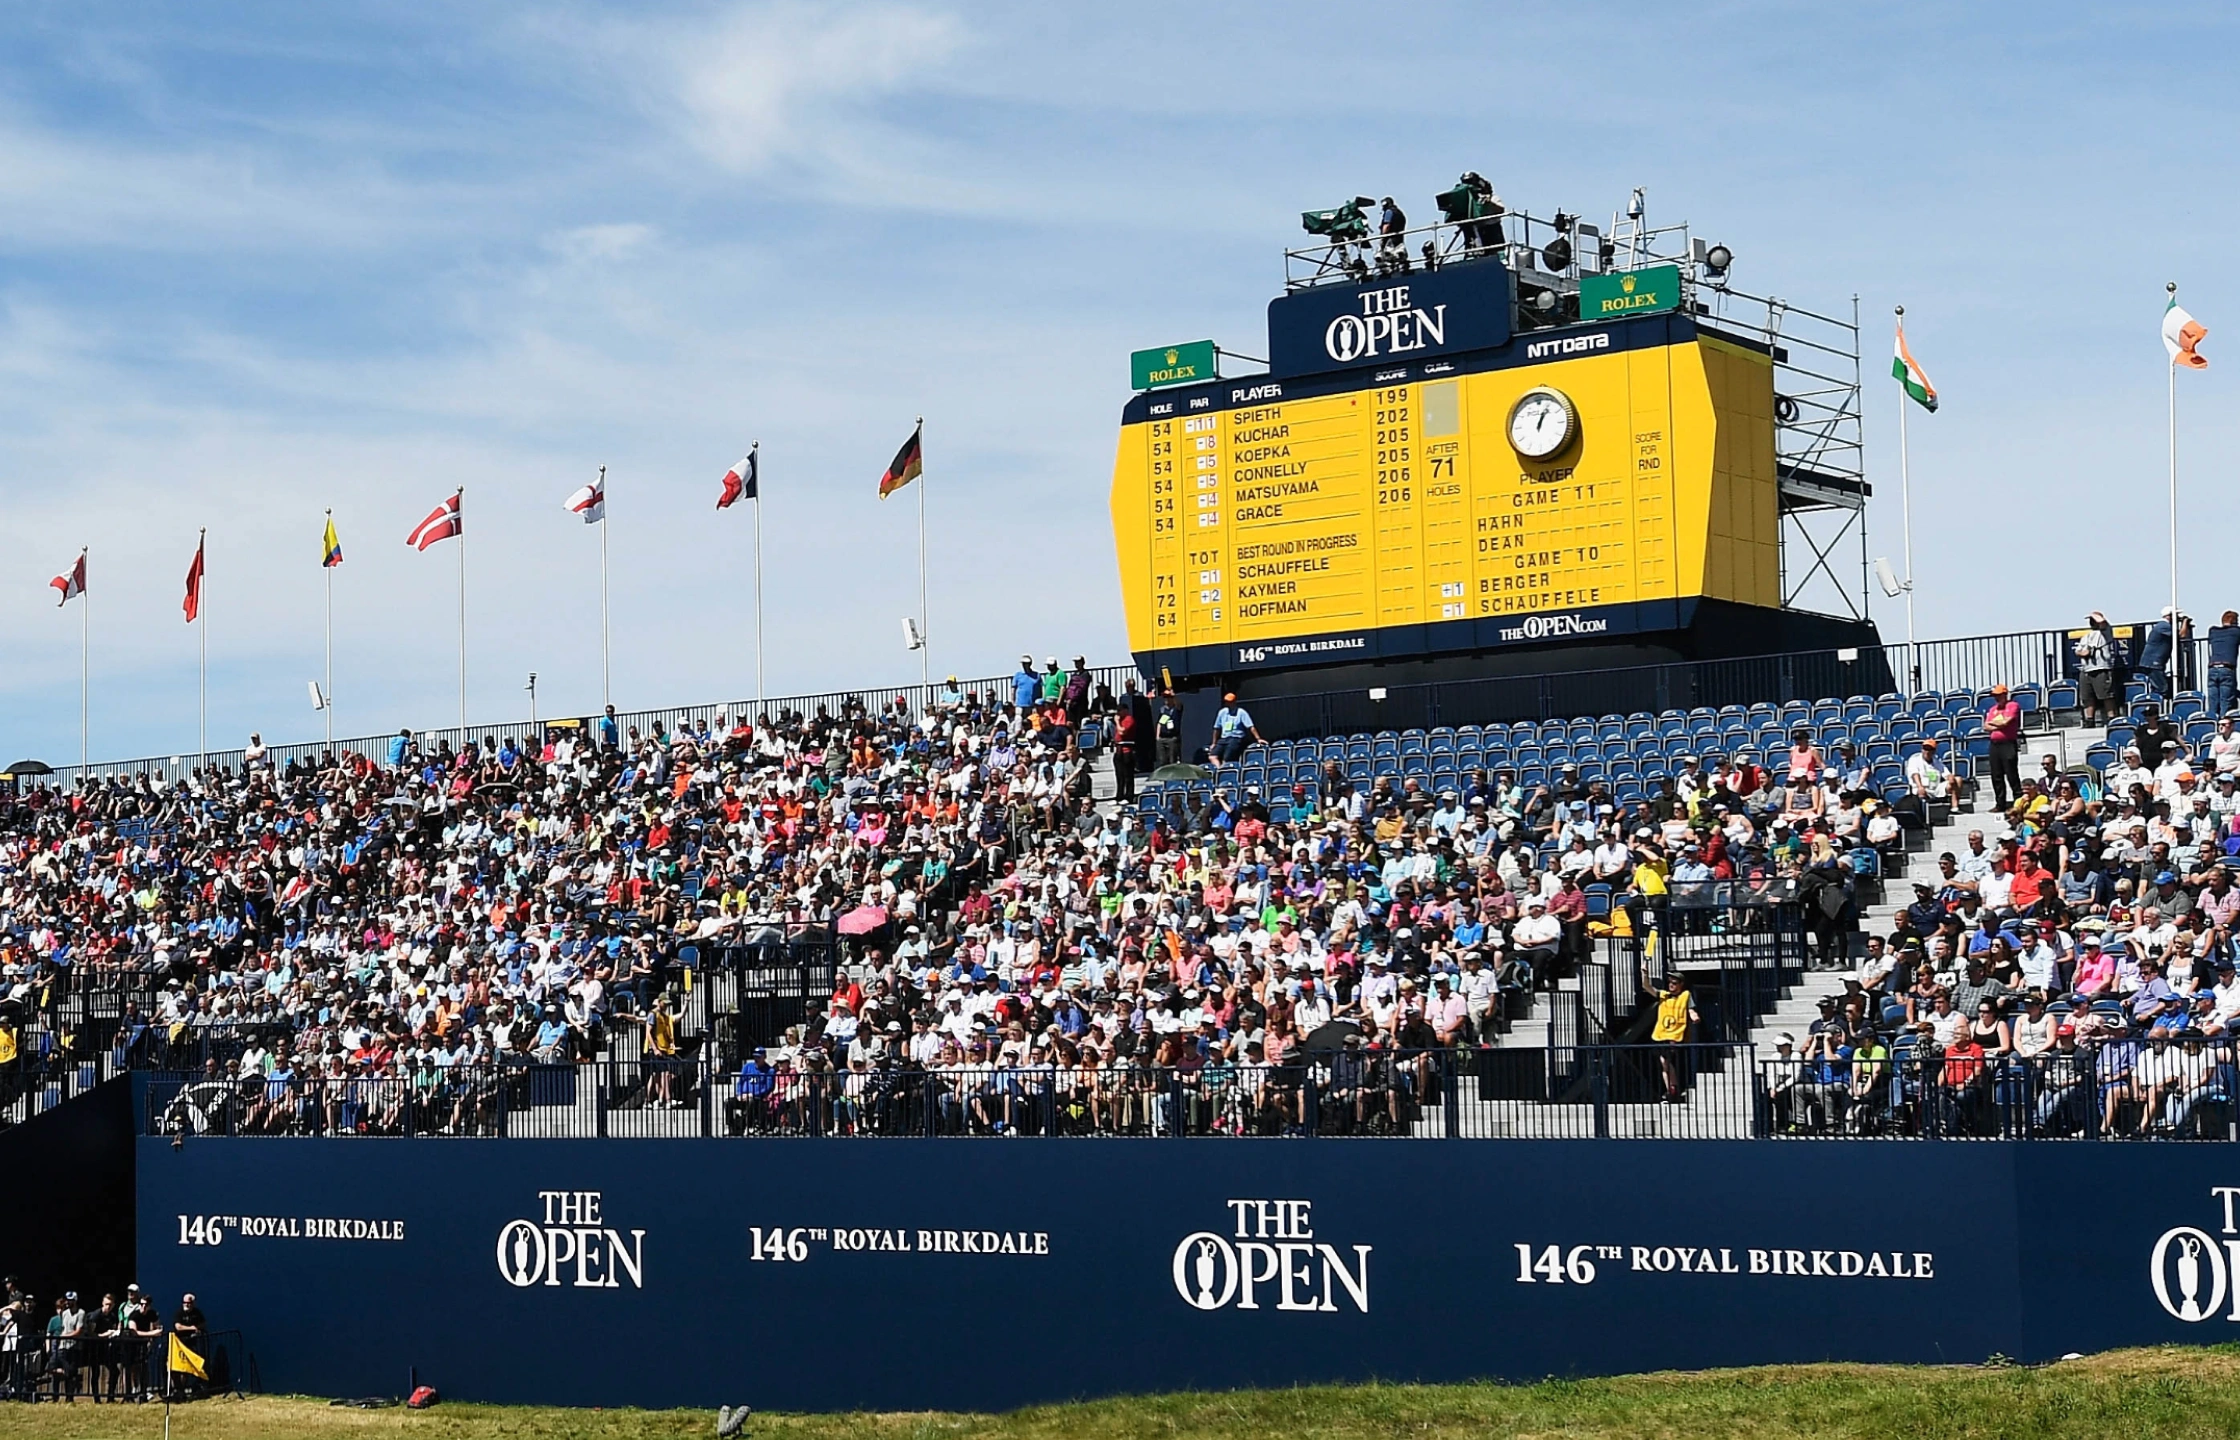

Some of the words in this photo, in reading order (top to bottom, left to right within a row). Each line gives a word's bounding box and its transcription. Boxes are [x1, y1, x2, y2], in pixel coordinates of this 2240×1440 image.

[1358, 286, 1411, 315] THE
[1602, 292, 1658, 312] ROLEX
[1325, 304, 1447, 362] OPEN
[1149, 365, 1197, 383] ROLEX
[1150, 403, 1173, 415] HOLE
[1190, 397, 1210, 409] PAR
[1232, 384, 1282, 403] PLAYER
[1153, 423, 1171, 437] 54
[1234, 407, 1281, 425] SPIETH
[1376, 388, 1408, 405] 199
[1153, 442, 1171, 456] 54
[1234, 425, 1289, 444] KUCHAR
[1376, 408, 1408, 425] 202
[1635, 431, 1662, 444] SCORE
[1154, 461, 1172, 475] 54
[1235, 445, 1290, 463] KOEPKA
[1377, 428, 1409, 444] 205
[1426, 442, 1459, 455] AFTER
[1641, 444, 1657, 456] FOR
[1154, 480, 1173, 494] 54
[1234, 461, 1307, 482] CONNELLY
[1378, 447, 1410, 464] 205
[1430, 457, 1454, 478] 71
[1519, 467, 1574, 485] PLAYER
[1638, 457, 1661, 471] RND
[1155, 498, 1174, 513] 54
[1236, 480, 1319, 502] MATSUYAMA
[1378, 467, 1411, 484] 206
[1427, 484, 1461, 497] HOLES
[1513, 489, 1559, 507] GAME
[1575, 485, 1595, 500] 11
[1155, 517, 1174, 532] 54
[1236, 504, 1283, 521] GRACE
[1379, 487, 1411, 504] 206
[1478, 514, 1523, 532] HAHN
[1189, 550, 1218, 565] TOT
[1237, 545, 1261, 560] BEST
[1262, 541, 1294, 557] ROUND
[1295, 540, 1305, 553] IN
[1306, 533, 1357, 552] PROGRESS
[1478, 534, 1524, 552] DEAN
[1515, 551, 1561, 569] GAME
[1577, 546, 1598, 562] 10
[1156, 575, 1174, 589] 71
[1238, 557, 1329, 579] SCHAUFFELE
[1480, 572, 1550, 593] BERGER
[1156, 594, 1176, 608] 72
[1238, 581, 1296, 599] KAYMER
[1481, 588, 1600, 613] SCHAUFFELE
[1157, 612, 1176, 627] 64
[1239, 599, 1307, 618] HOFFMAN
[1275, 643, 1308, 654] ROYAL
[1310, 638, 1365, 651] BIRKDALE
[538, 1191, 603, 1225] THE
[1227, 1199, 1313, 1239] THE
[242, 1216, 300, 1237] ROYAL
[304, 1218, 404, 1240] BIRKDALE
[834, 1228, 911, 1252] ROYAL
[917, 1230, 1049, 1255] BIRKDALE
[497, 1219, 646, 1289] OPEN
[1631, 1247, 1739, 1273] ROYAL
[1748, 1249, 1934, 1279] BIRKDALE
[1173, 1231, 1373, 1313] OPEN
